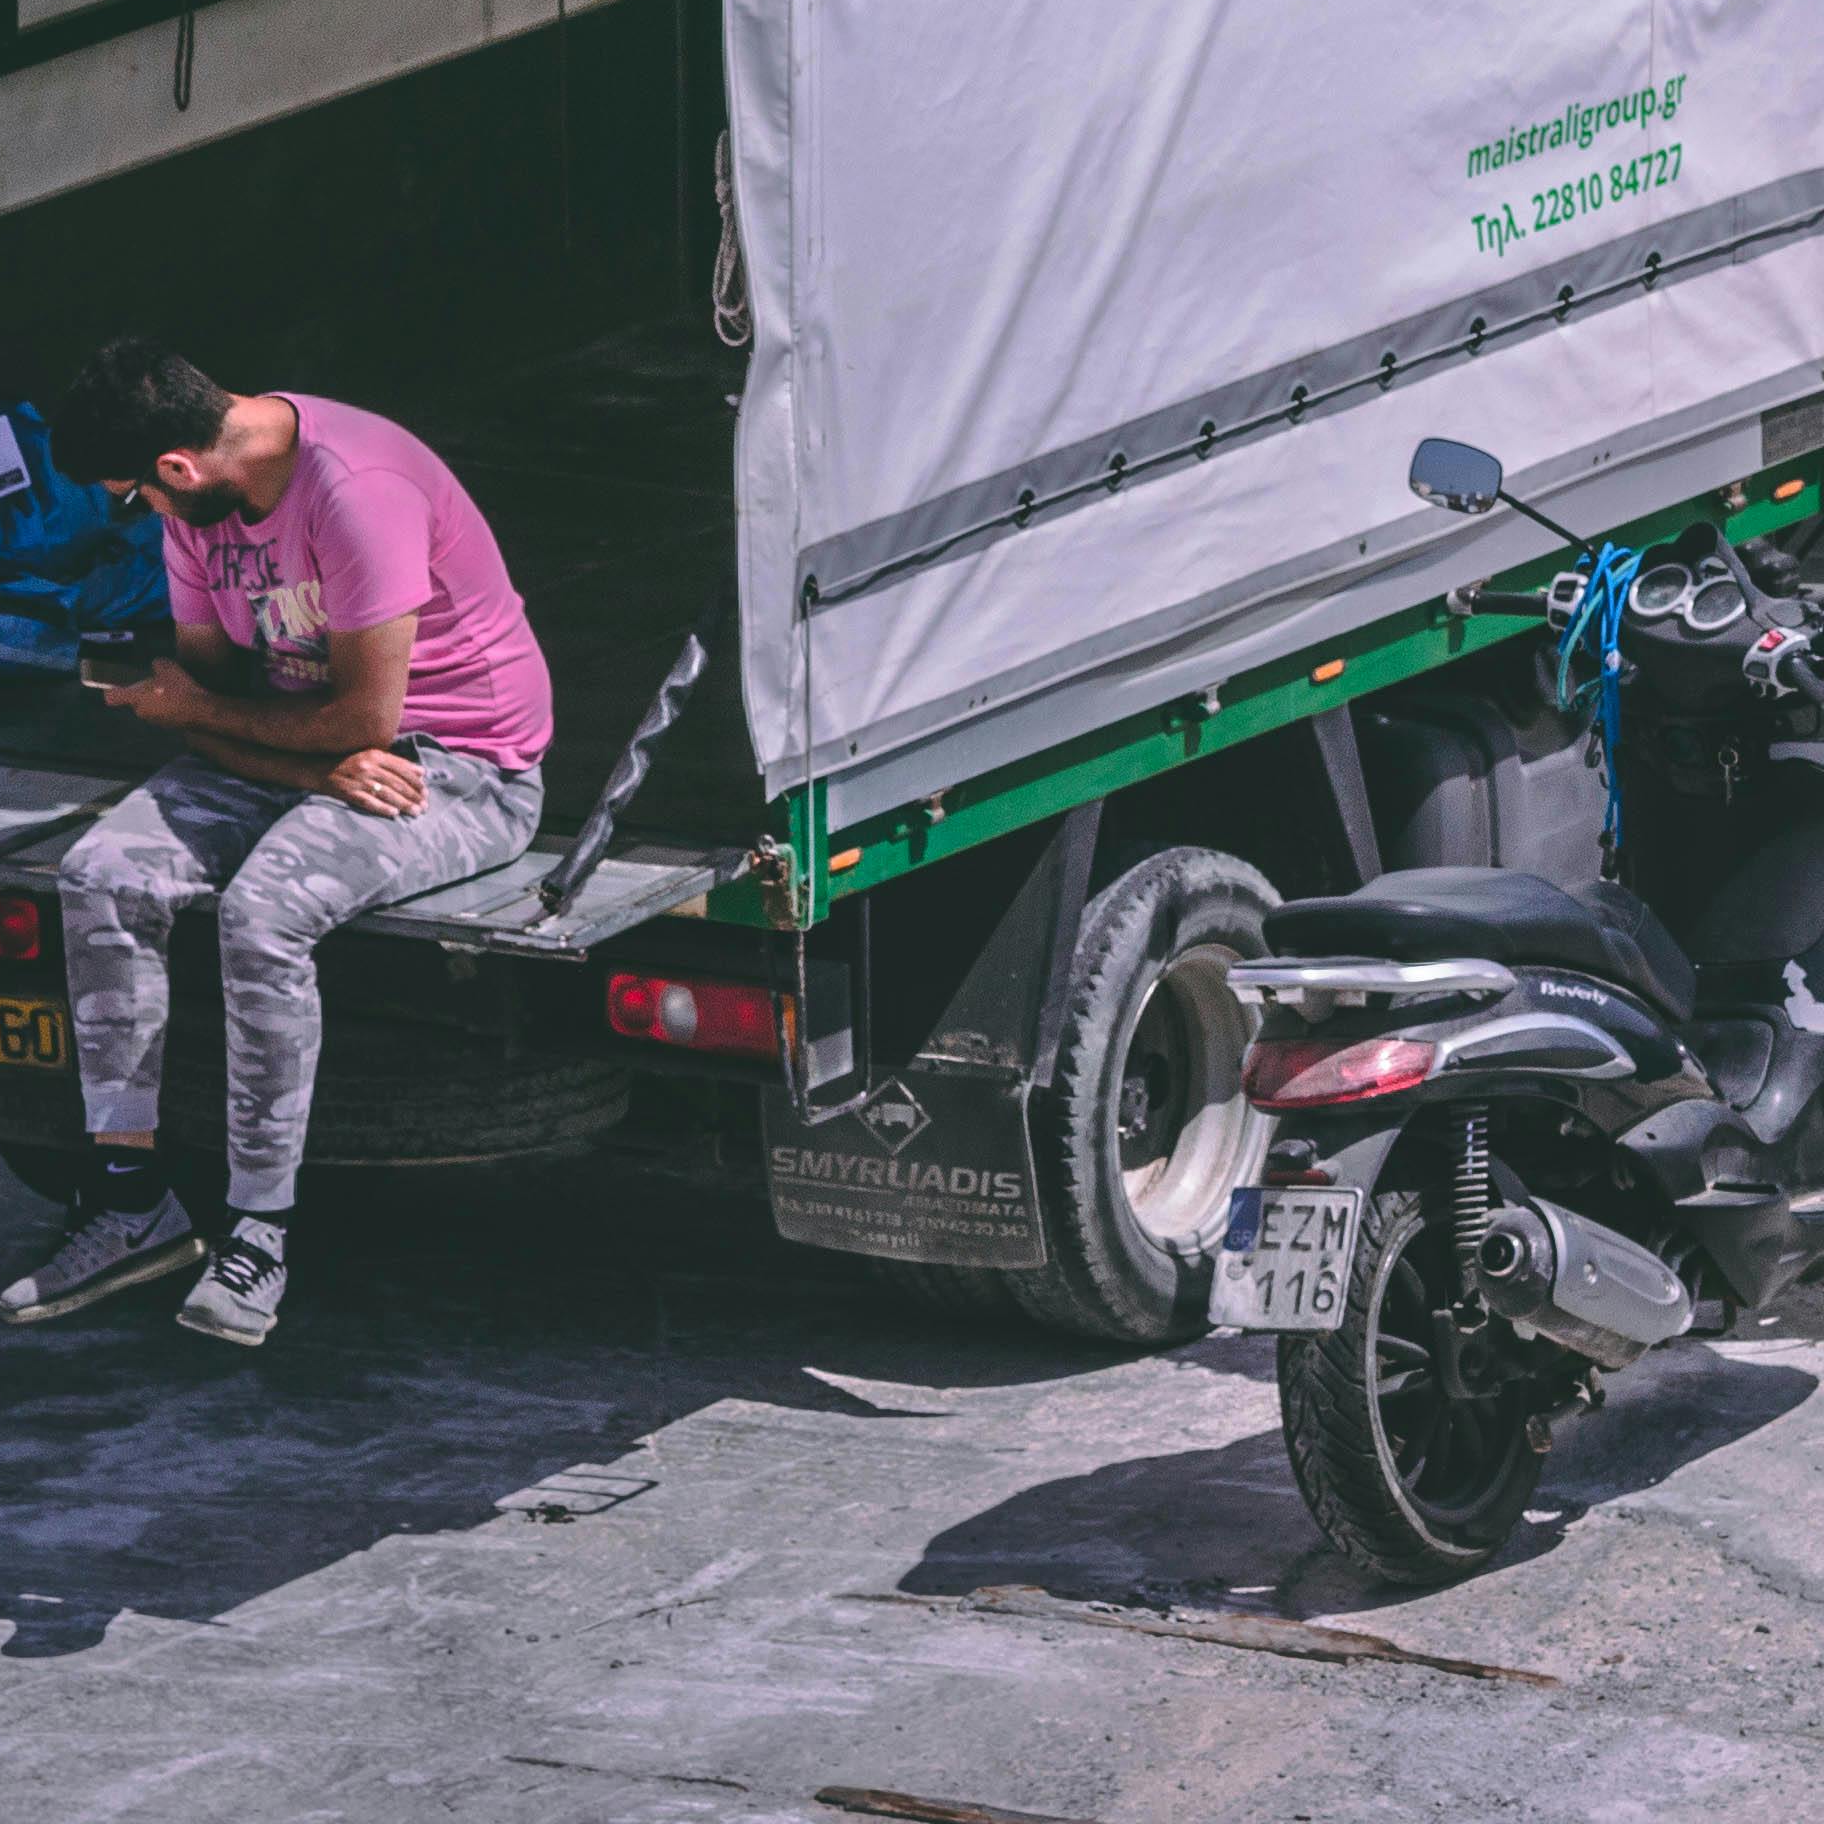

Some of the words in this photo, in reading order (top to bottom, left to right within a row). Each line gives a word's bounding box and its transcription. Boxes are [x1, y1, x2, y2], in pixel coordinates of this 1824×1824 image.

[1466, 73, 1687, 178] maistraligroup.gr
[1471, 203, 1527, 257] Τηλ.
[1532, 171, 1603, 234] 22810
[1609, 143, 1683, 203] 84727
[1540, 980, 1609, 1007] Beverly
[771, 1146, 1023, 1199] SMYRLIADIS
[1258, 1203, 1349, 1252] EZM
[1256, 1269, 1338, 1315] 116
